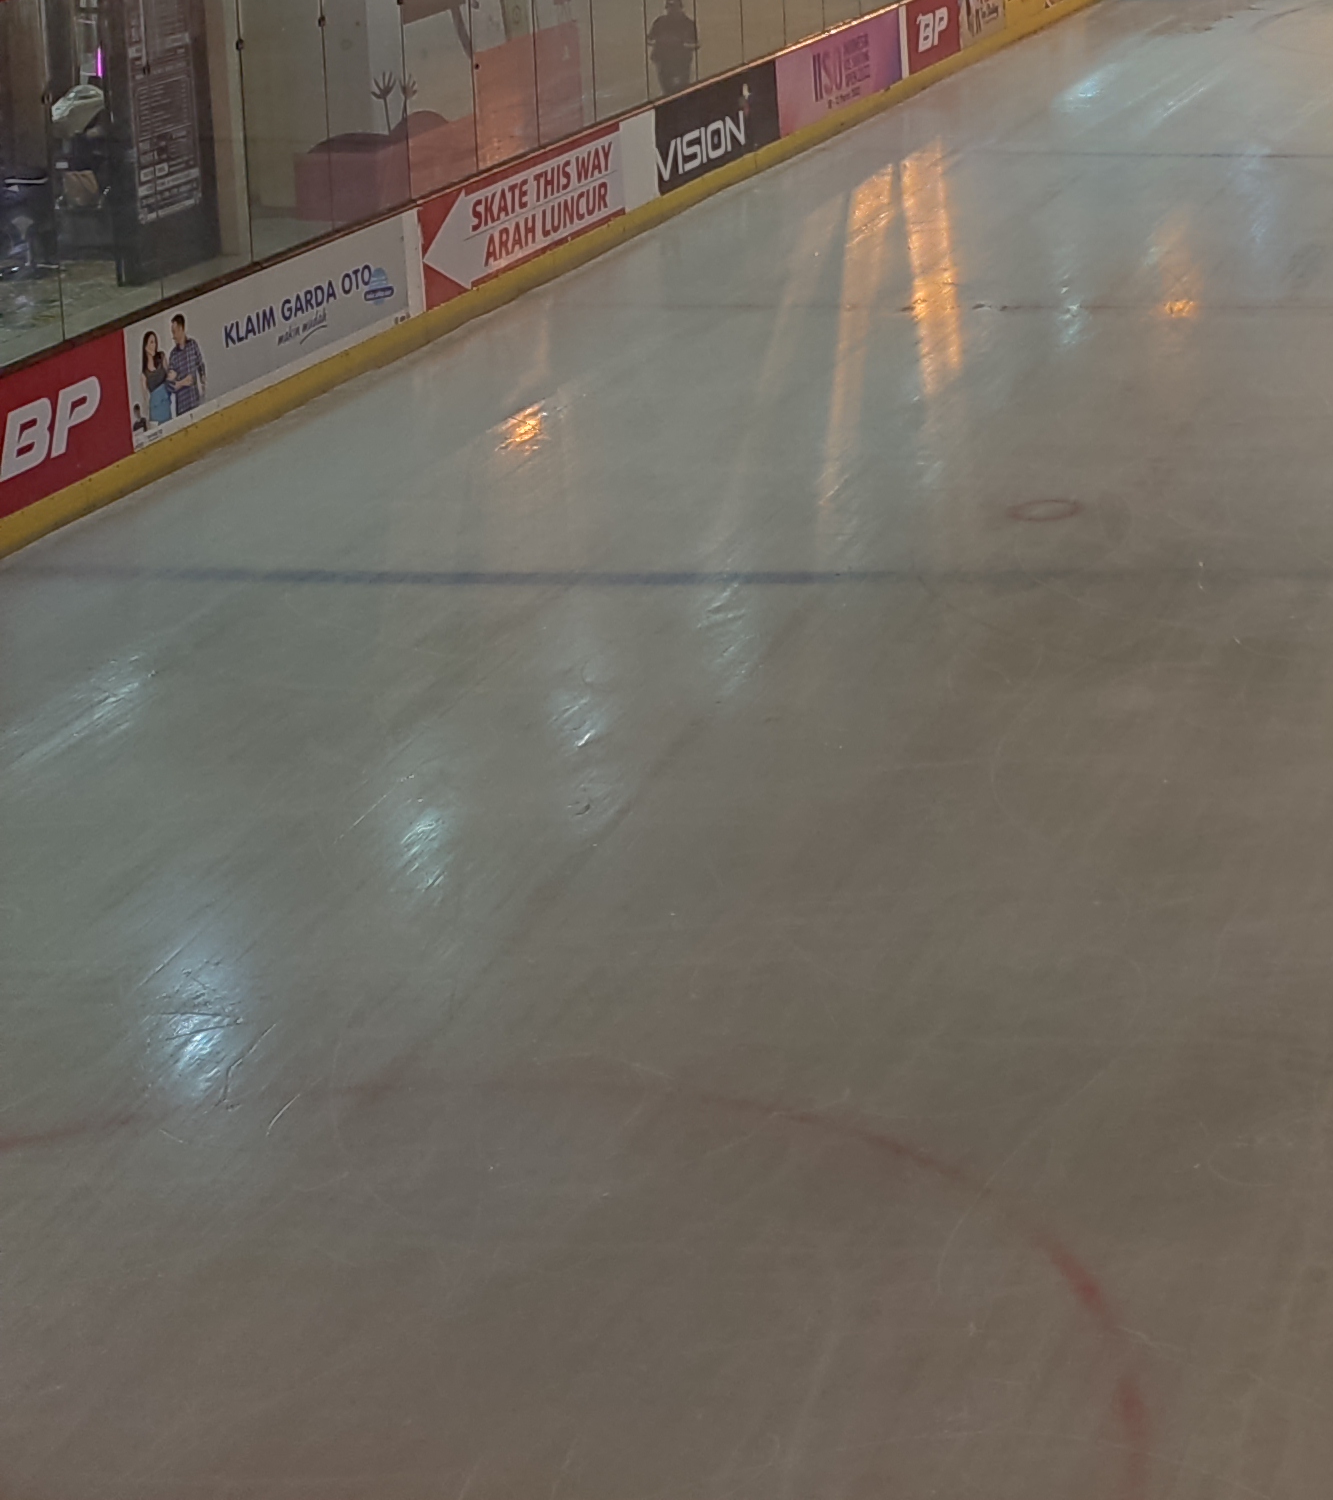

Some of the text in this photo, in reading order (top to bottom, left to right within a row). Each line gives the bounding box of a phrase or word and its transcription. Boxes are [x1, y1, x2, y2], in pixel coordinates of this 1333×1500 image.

[471, 141, 613, 232] SKATE THIS WAY
[655, 110, 745, 181] VISION
[484, 181, 609, 267] ARAH LUNCUR
[223, 263, 373, 348] KLAIM GARDA OTO
